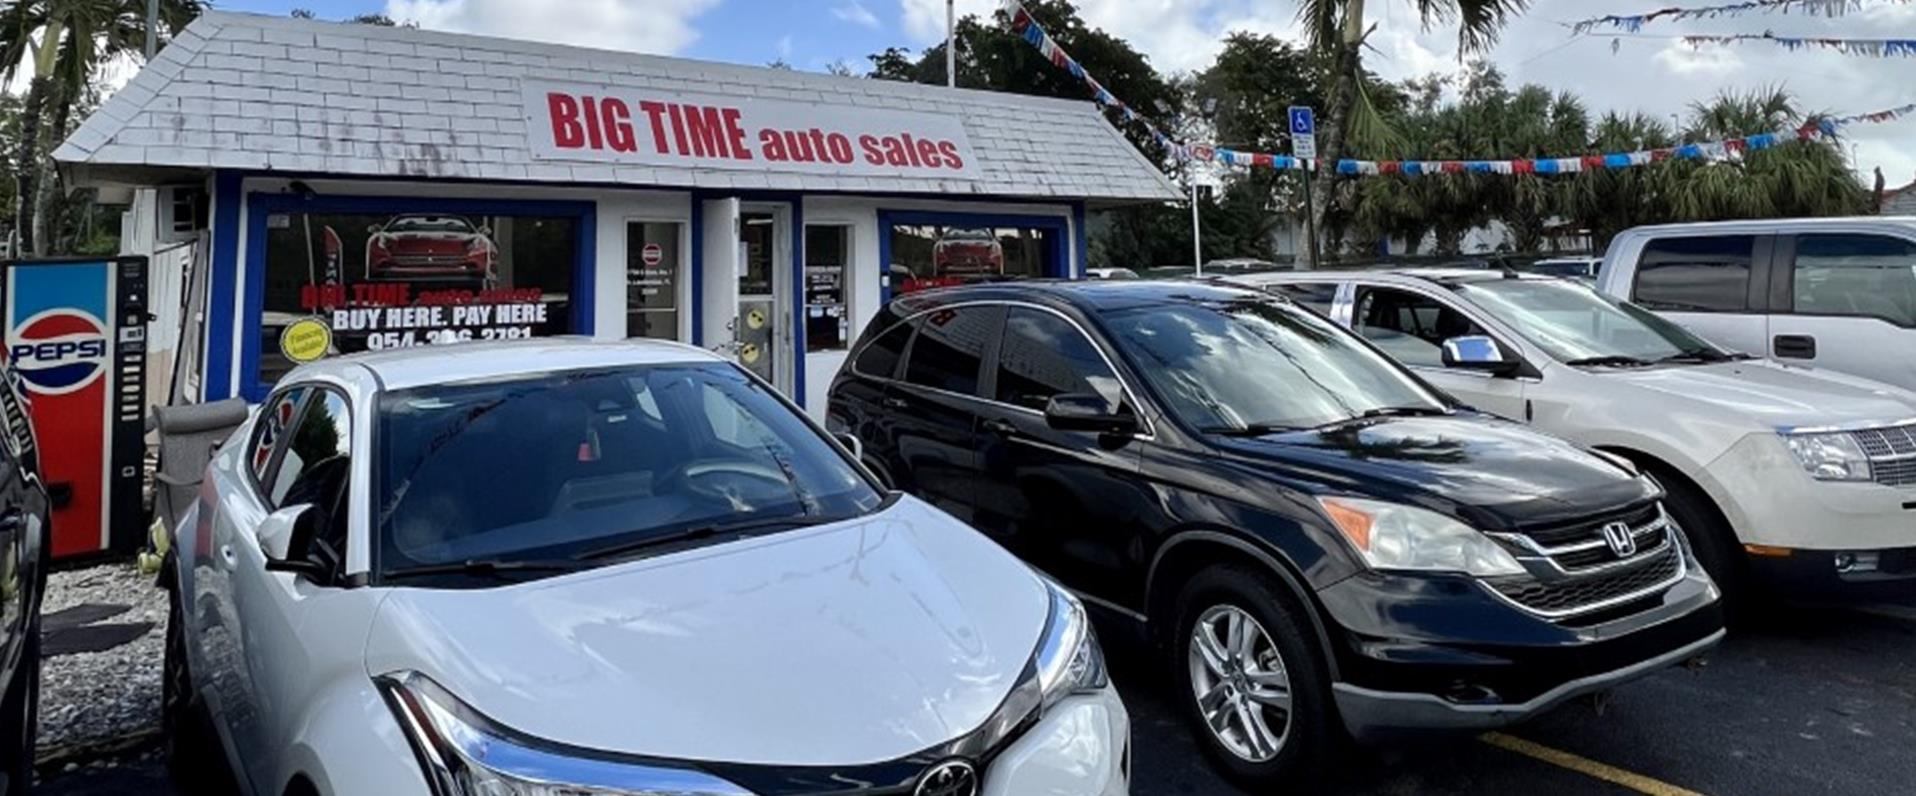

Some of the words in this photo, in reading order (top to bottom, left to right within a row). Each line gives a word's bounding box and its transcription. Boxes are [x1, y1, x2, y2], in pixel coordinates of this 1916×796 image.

[547, 92, 638, 153] BIG
[640, 101, 753, 160] TIME
[758, 127, 854, 165] auto
[858, 132, 964, 170] sales
[352, 283, 410, 306] TIME
[333, 309, 382, 330] BUY
[386, 306, 448, 328] HERE.
[453, 306, 492, 326] PAY
[496, 303, 548, 324] HERE
[12, 339, 106, 362] PEPSI
